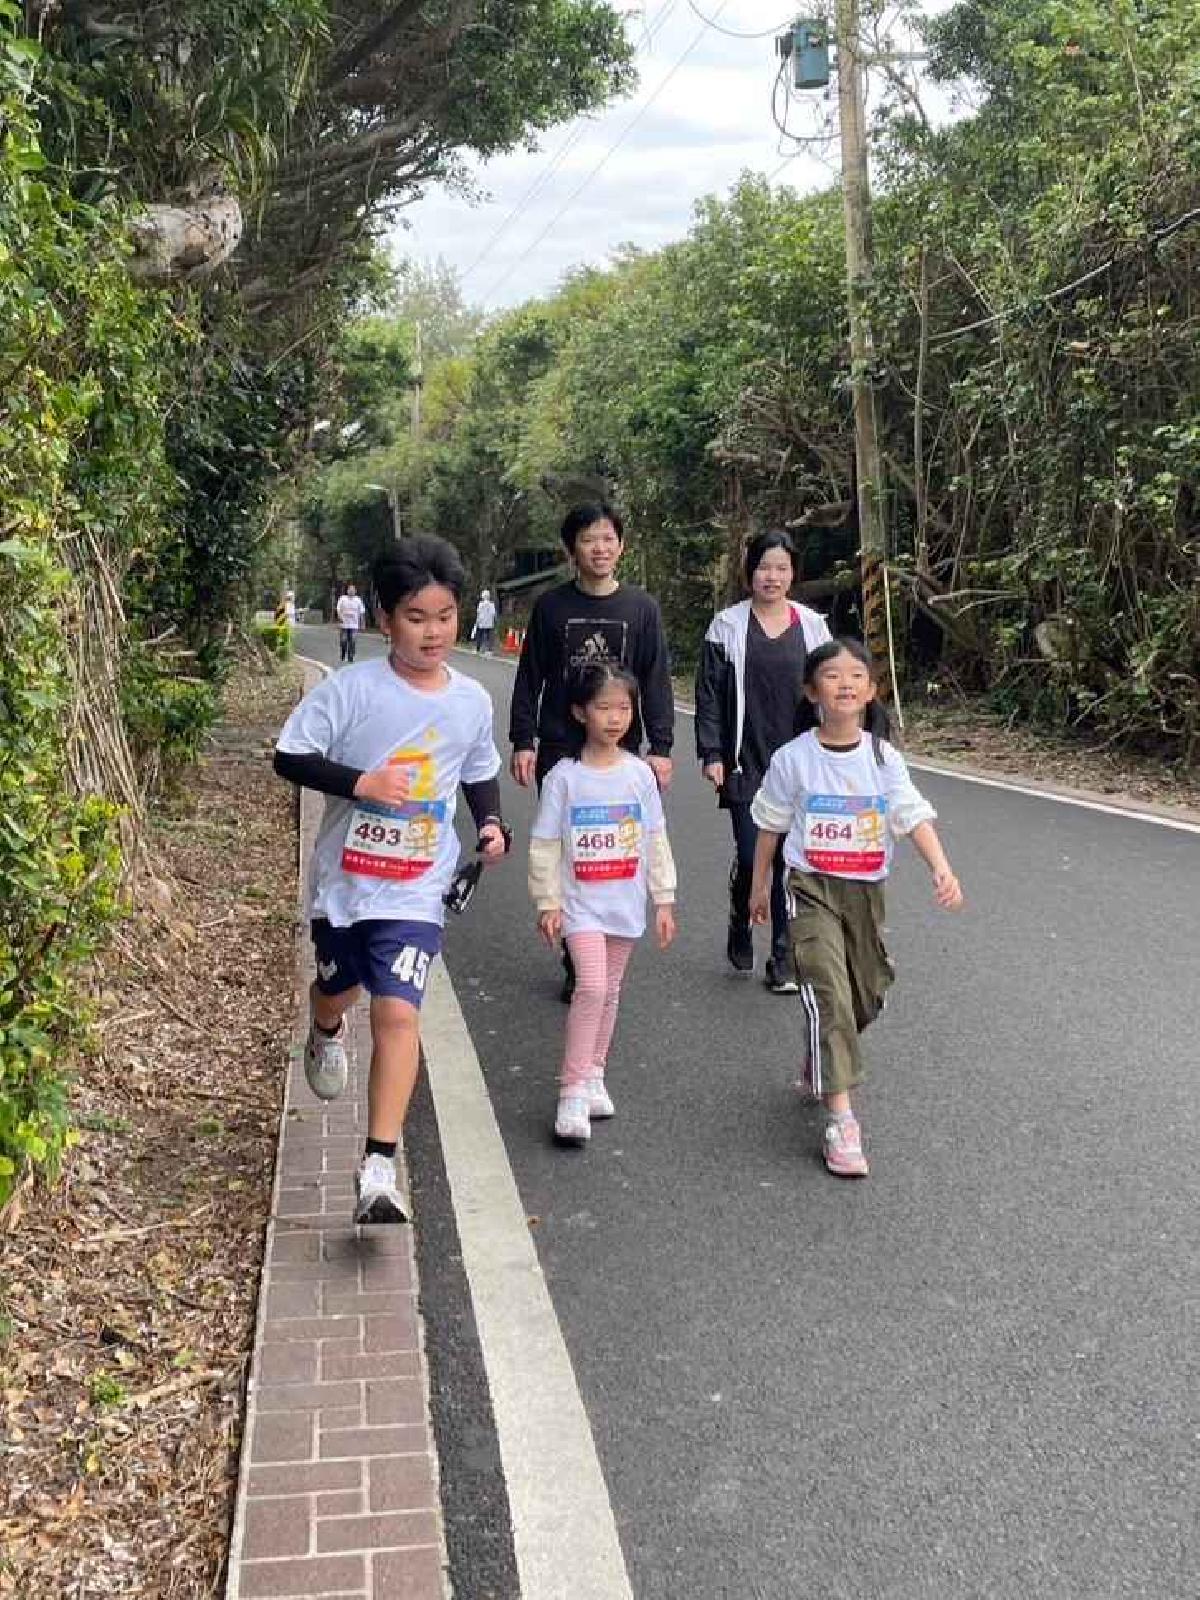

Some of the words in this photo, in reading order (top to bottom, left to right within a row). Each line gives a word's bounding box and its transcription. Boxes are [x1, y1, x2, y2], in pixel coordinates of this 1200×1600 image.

[354, 822, 401, 847] 493
[577, 833, 615, 850] 468
[811, 823, 852, 840] 464
[391, 946, 430, 991] 45
